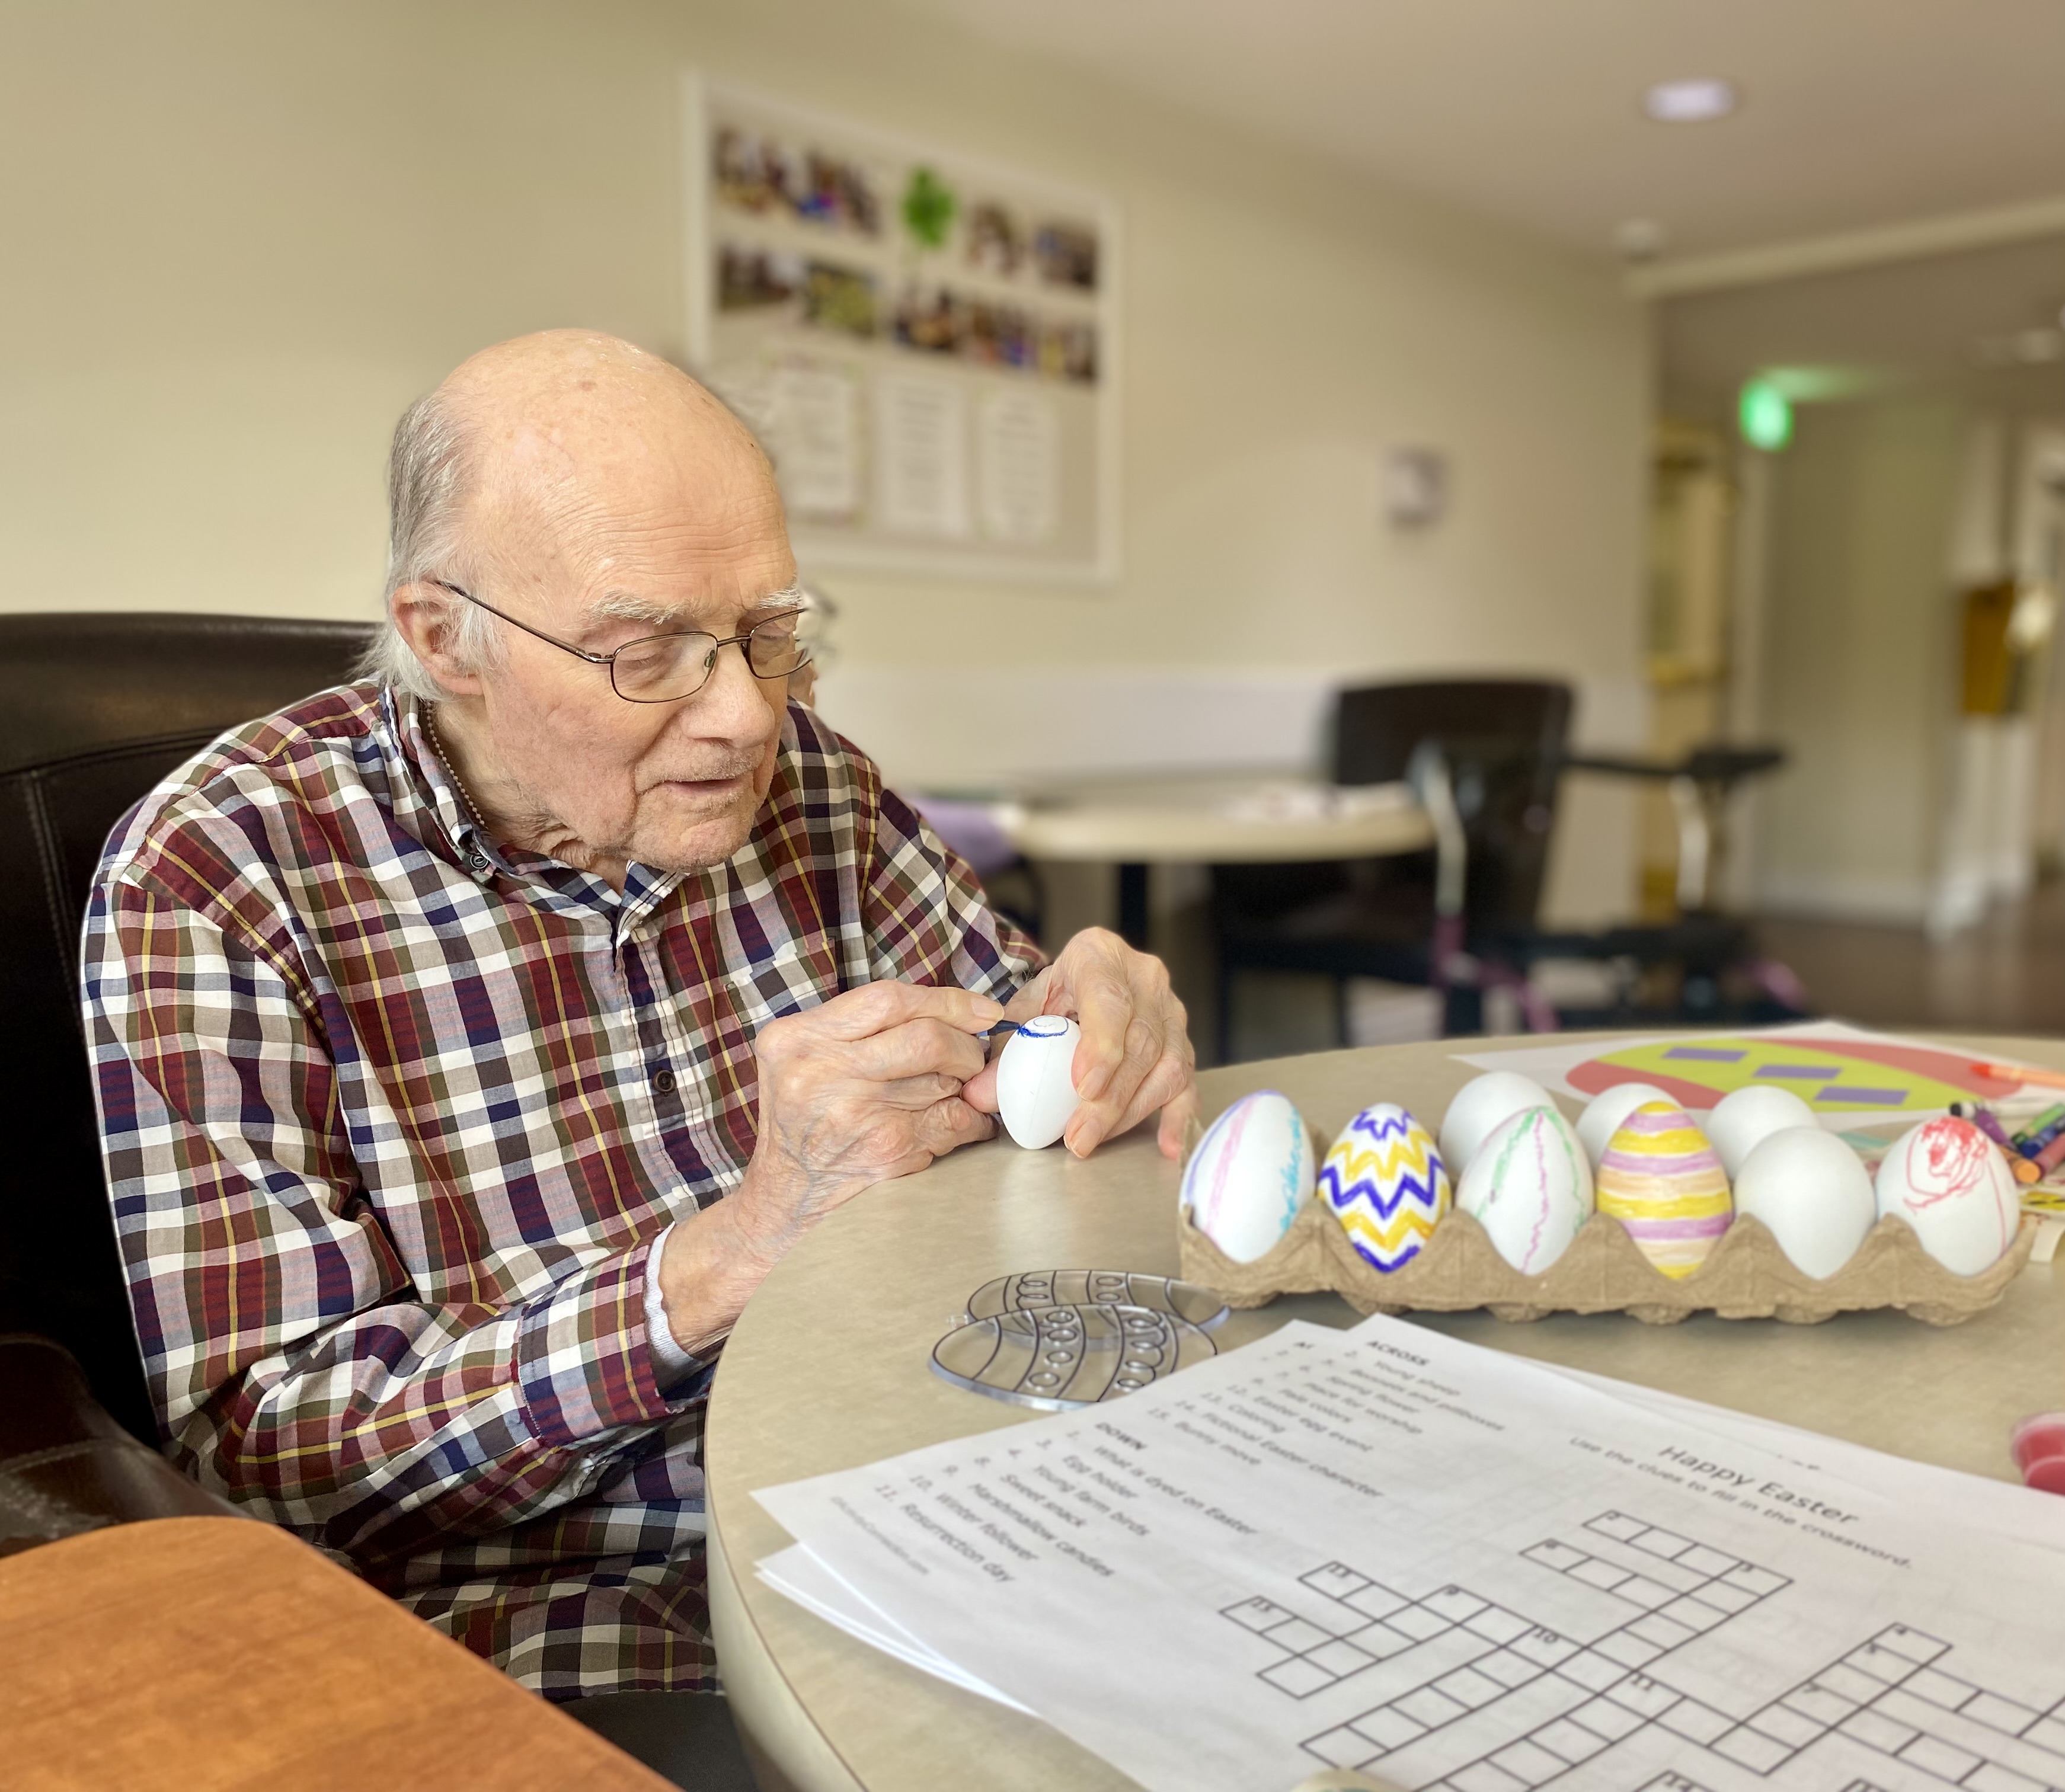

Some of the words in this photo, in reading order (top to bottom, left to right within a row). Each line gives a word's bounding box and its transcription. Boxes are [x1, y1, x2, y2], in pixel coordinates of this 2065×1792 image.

[1364, 1336, 1431, 1367] ACROSS
[1094, 1421, 1147, 1451] DOWN
[1227, 1403, 1286, 1434] Coloring
[1252, 1394, 1300, 1417] Easter
[1299, 1416, 1329, 1433] egg
[1328, 1431, 1374, 1452] event
[1309, 1401, 1353, 1423] colors
[1364, 1407, 1423, 1435] worship
[1173, 1421, 1220, 1445] Bunny
[1219, 1441, 1262, 1466] move
[1201, 1411, 1263, 1443] Fictional
[1258, 1438, 1309, 1465] Easter
[1307, 1462, 1384, 1498] character
[999, 1473, 1047, 1503] Sweet
[1041, 1499, 1088, 1529] snack
[1032, 1464, 1077, 1493] Young
[1073, 1489, 1112, 1514] farm
[1108, 1510, 1152, 1537] birds
[1062, 1454, 1093, 1475] Egg
[1089, 1470, 1140, 1499] holder
[1094, 1445, 1133, 1470] What
[1129, 1466, 1147, 1478] is
[1144, 1474, 1187, 1499] dyed
[1181, 1495, 1206, 1510] on
[1203, 1505, 1261, 1535] Easter
[1569, 1436, 1603, 1453] Use
[1603, 1449, 1635, 1465] the
[1636, 1461, 1685, 1484] clues
[1686, 1480, 1708, 1493] to
[1711, 1487, 1739, 1503] fill
[1738, 1497, 1760, 1511] in
[1762, 1508, 1797, 1525] the
[1800, 1522, 1913, 1570] crossword.
[1658, 1445, 1757, 1487] Happy
[1757, 1481, 1861, 1523] Easter
[899, 1500, 986, 1564] Resurrection
[981, 1560, 1017, 1584] day
[935, 1491, 984, 1524] Winter
[978, 1521, 1040, 1562] follower
[965, 1482, 1059, 1543] Marshmallow
[1054, 1540, 1116, 1578] candies
[1533, 1626, 1559, 1644] 10
[1629, 1673, 1658, 1693] 11
